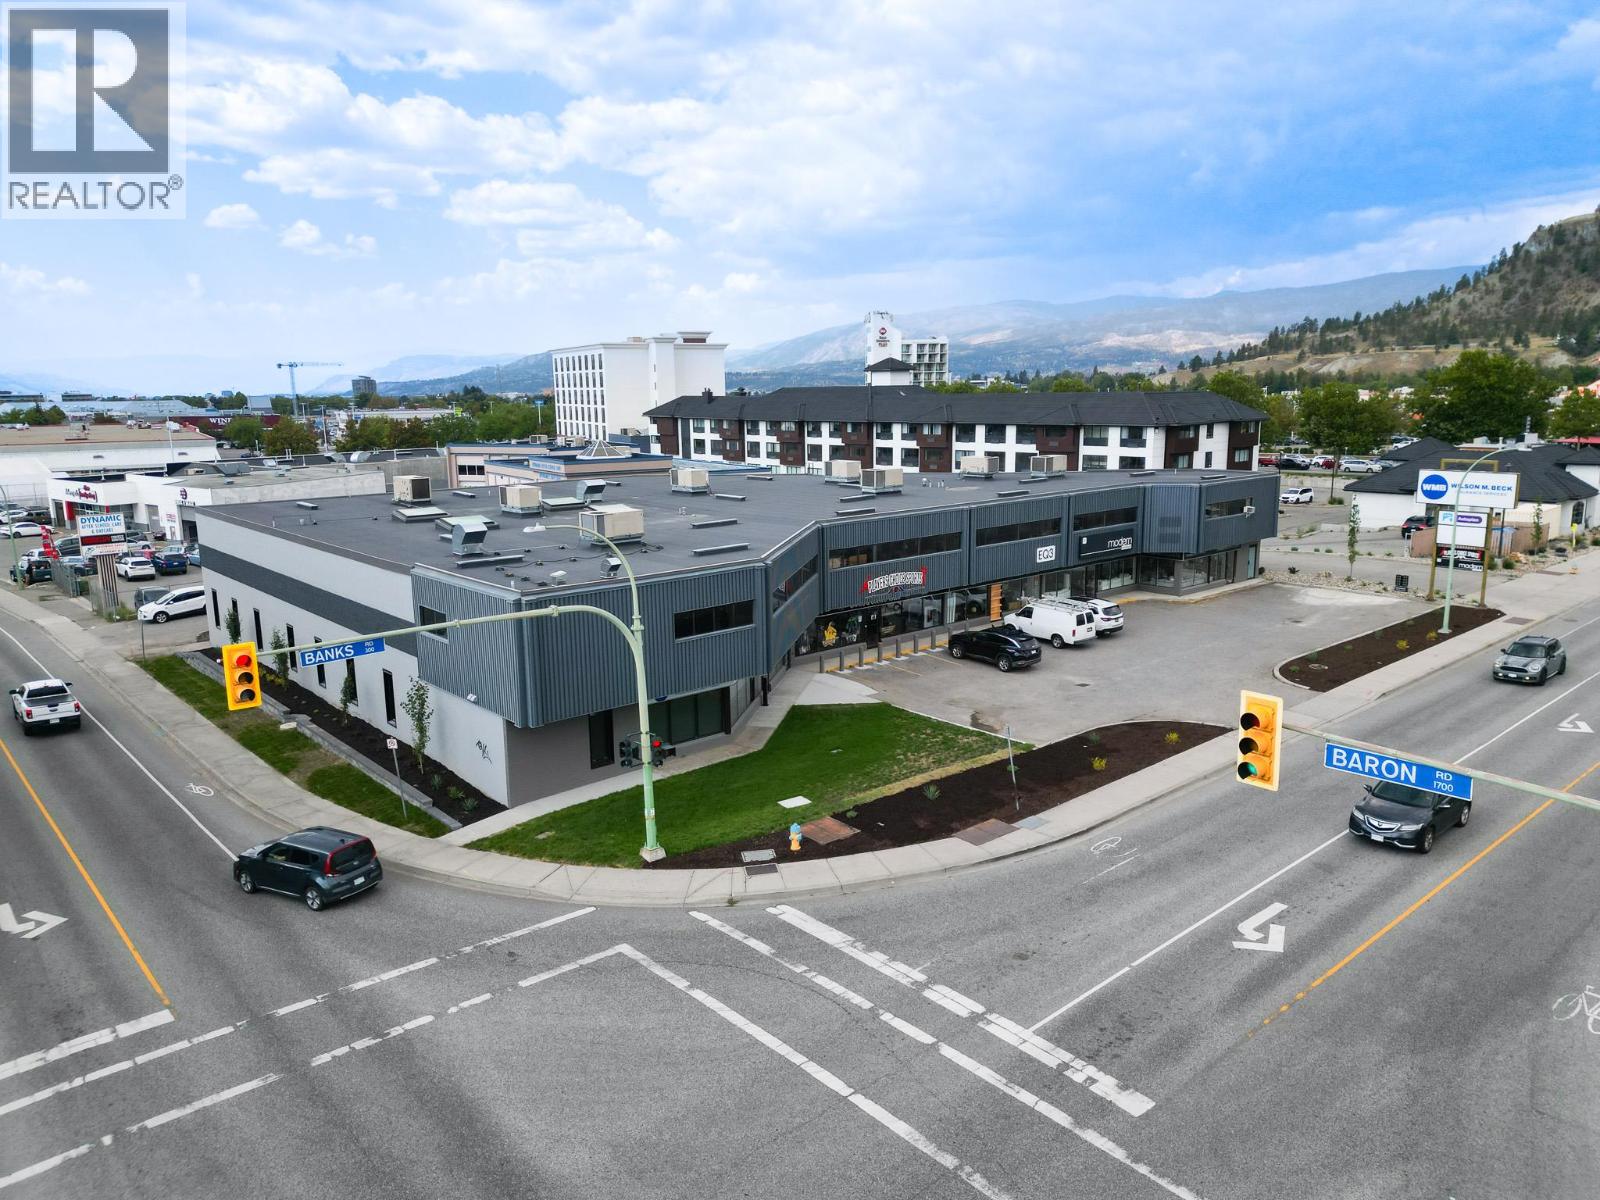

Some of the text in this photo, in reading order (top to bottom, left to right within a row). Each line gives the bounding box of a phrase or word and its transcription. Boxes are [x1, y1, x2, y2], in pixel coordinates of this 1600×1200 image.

[1422, 483, 1447, 491] WMB
[80, 515, 122, 524] DYNAMIC
[1038, 548, 1054, 561] EQ3
[305, 645, 354, 664] BANKS
[1333, 748, 1453, 783] BARON RD
[1433, 780, 1454, 792] 1700
